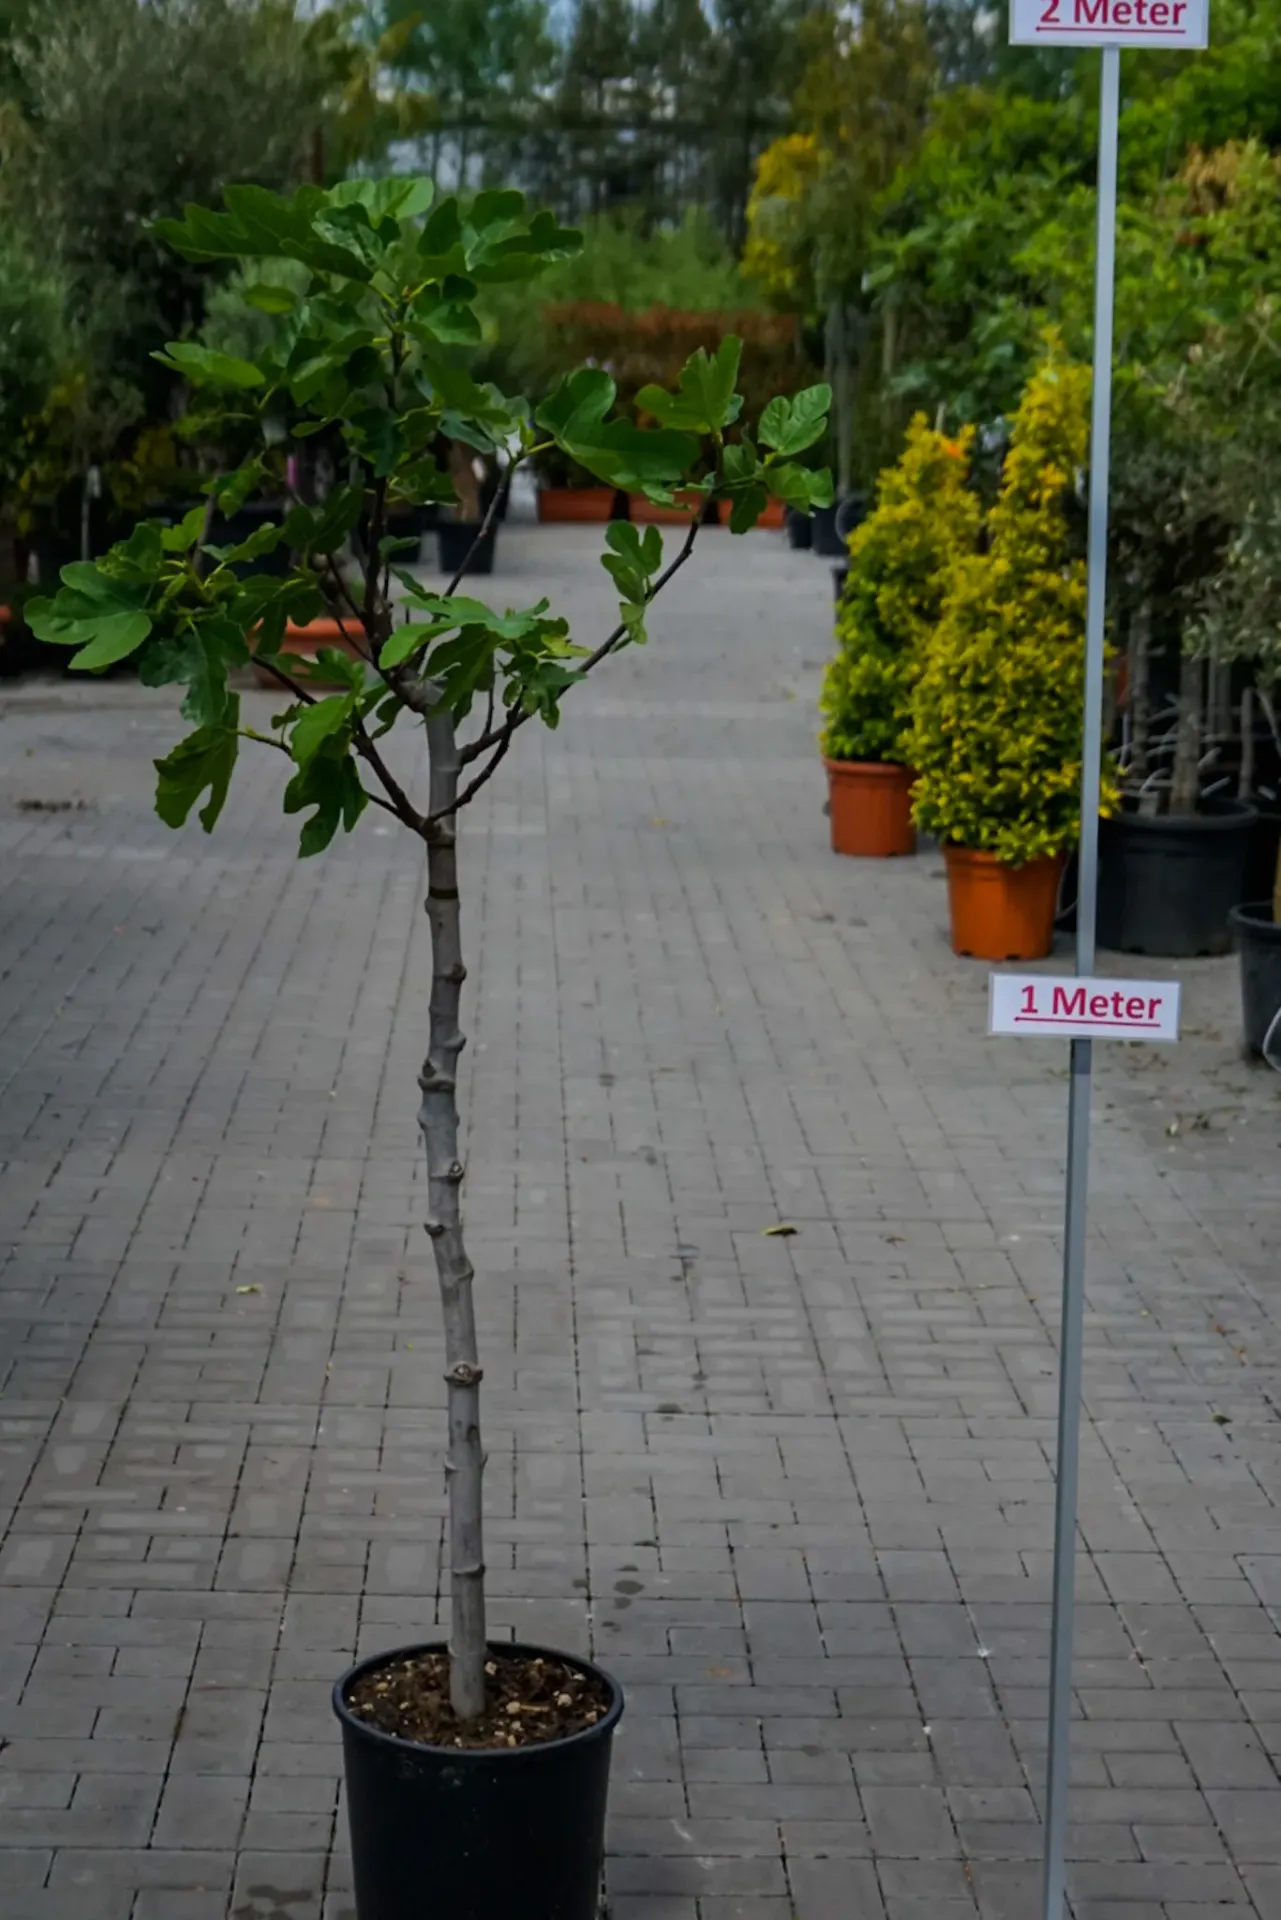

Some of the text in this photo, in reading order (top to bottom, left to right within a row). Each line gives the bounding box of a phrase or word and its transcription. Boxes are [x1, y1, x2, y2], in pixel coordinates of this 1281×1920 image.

[1040, 0, 1187, 26] 2 Meter
[1021, 984, 1162, 1020] 1 Meter
